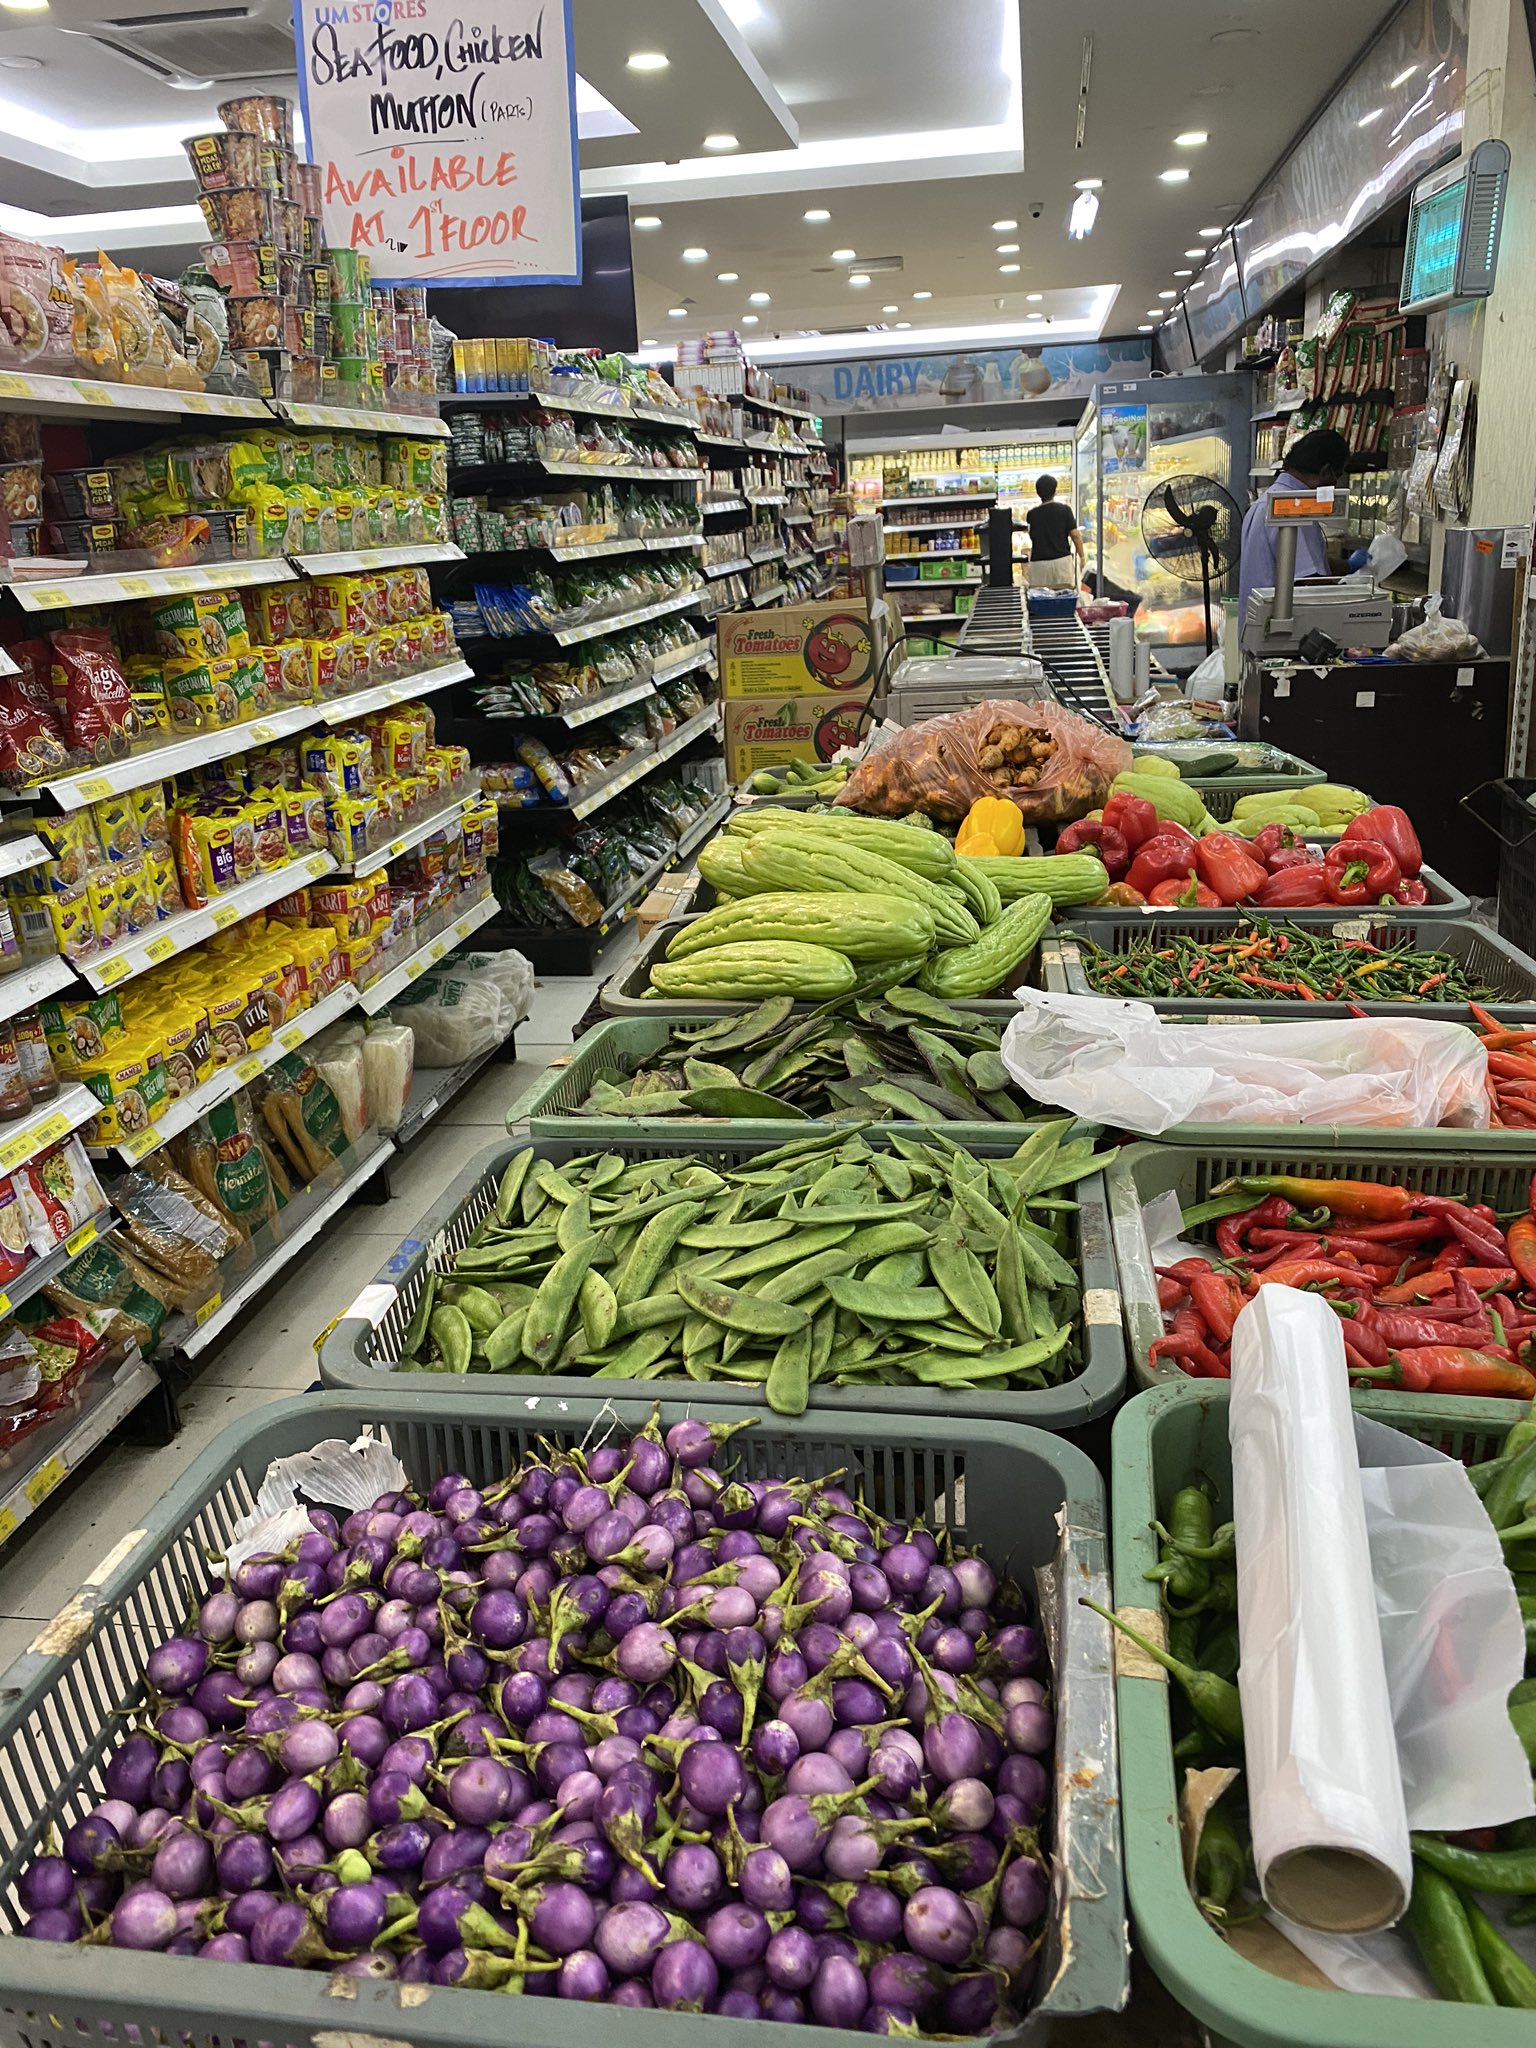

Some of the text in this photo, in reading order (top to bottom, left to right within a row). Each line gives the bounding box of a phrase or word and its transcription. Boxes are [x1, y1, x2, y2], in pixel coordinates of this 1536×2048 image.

[370, 72, 485, 134] MUTTON
[350, 210, 385, 249] AT
[439, 204, 538, 252] FLOOR
[834, 361, 922, 400] DAIRY
[159, 607, 195, 628] VEGETARIAN
[747, 628, 775, 640] Fresh
[735, 636, 802, 653] Tomatoes
[175, 673, 211, 694] VEGETARIAN
[746, 724, 811, 741] Tomatoes
[397, 752, 412, 764] Kari
[467, 836, 482, 847] BIG
[216, 850, 233, 868] BIG
[278, 895, 300, 914] KARI
[319, 891, 342, 911] KARI
[370, 892, 389, 915] KARI
[263, 971, 278, 984] AMEE
[214, 997, 242, 1015] MAMEE
[245, 999, 269, 1028] ITIK
[168, 1027, 192, 1046] MAMEE
[116, 1064, 142, 1082] MAMEE
[54, 1211, 68, 1238] MTR
